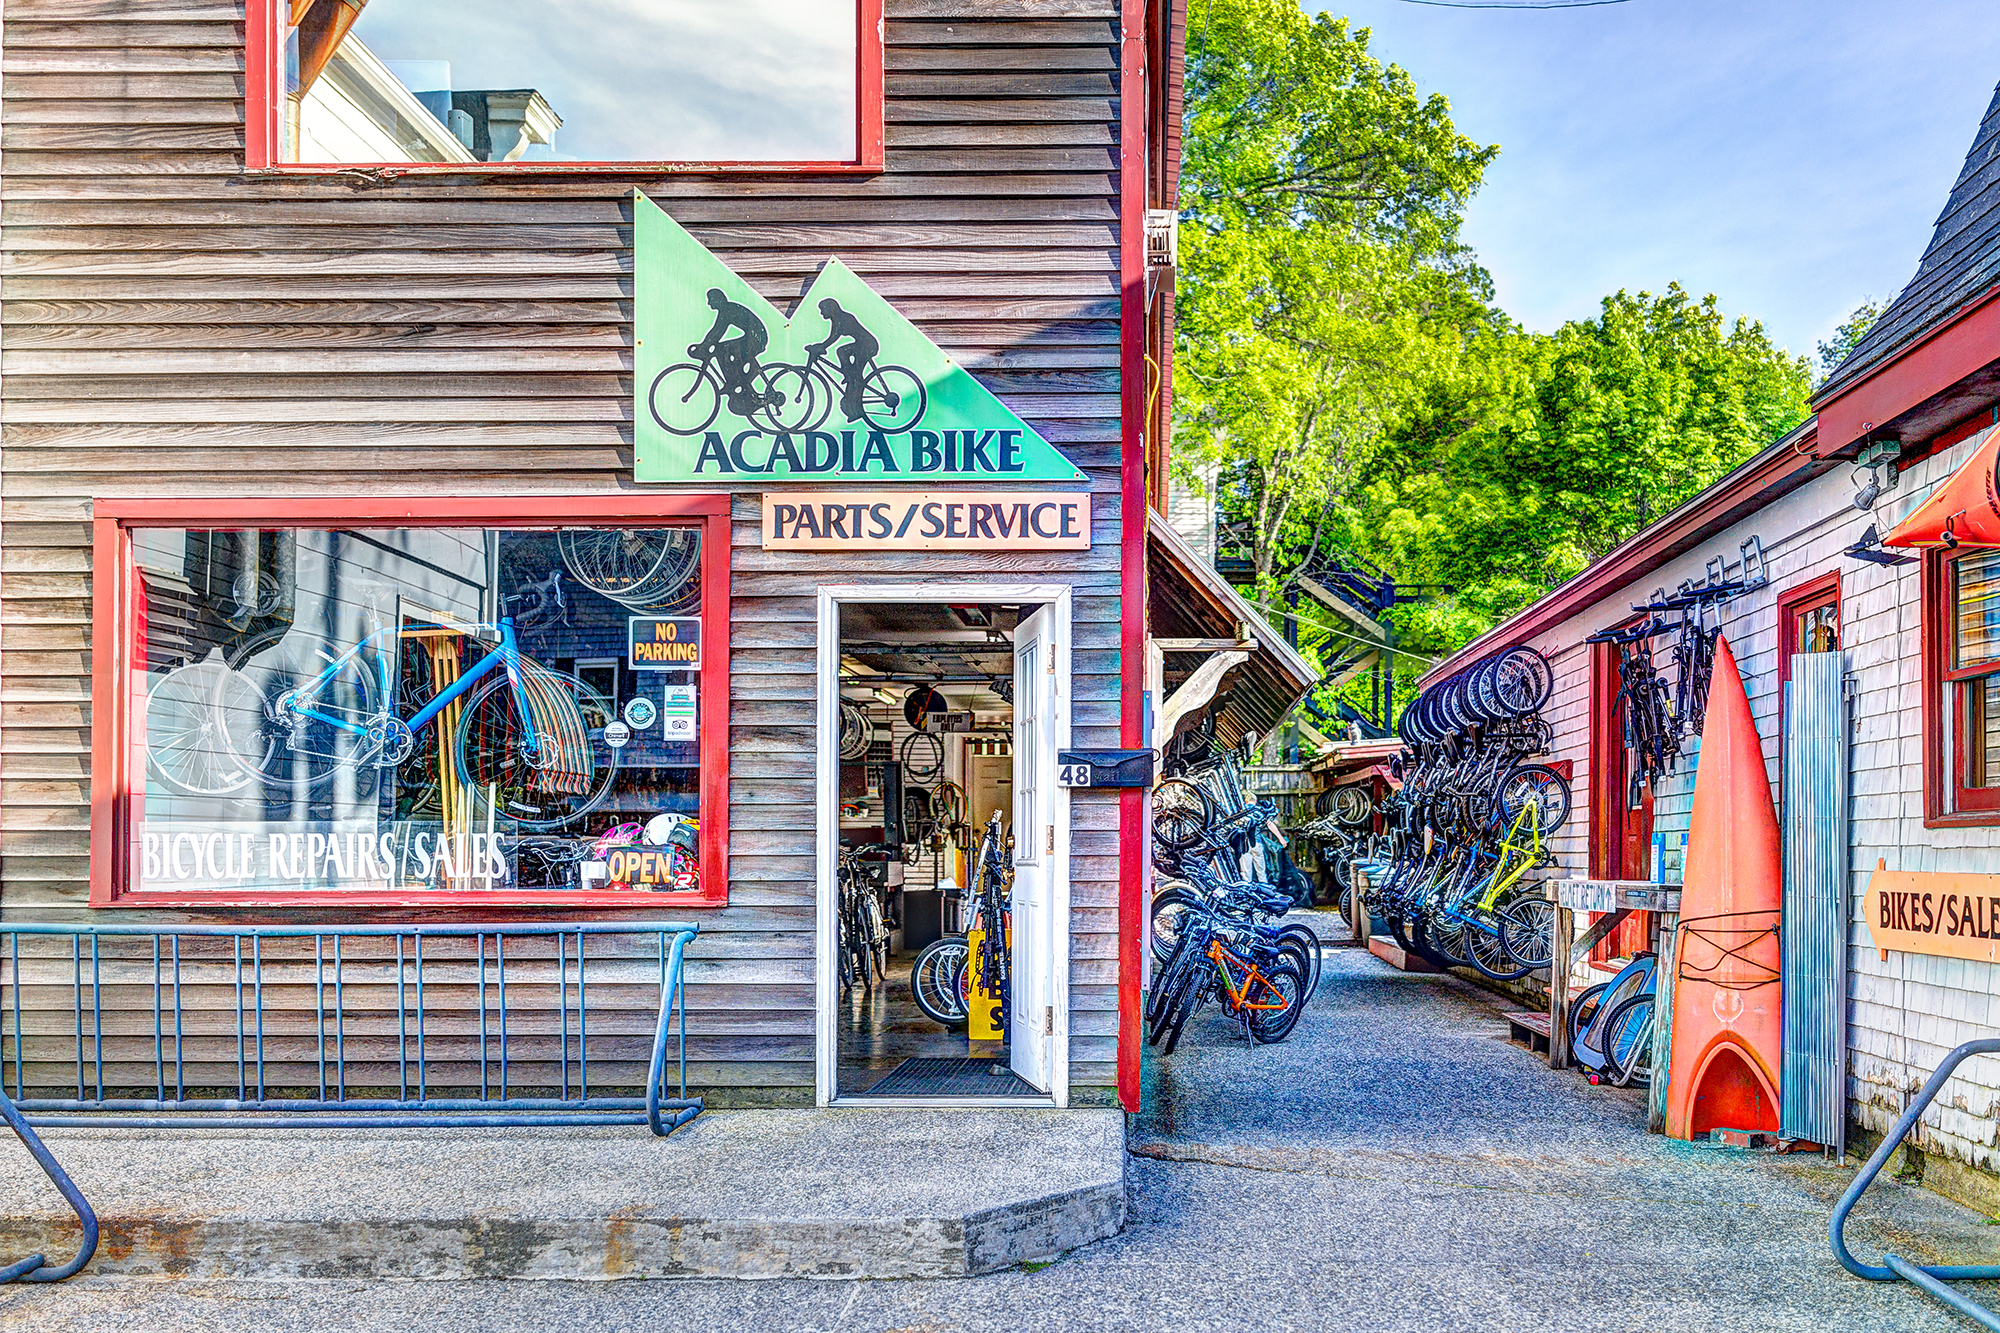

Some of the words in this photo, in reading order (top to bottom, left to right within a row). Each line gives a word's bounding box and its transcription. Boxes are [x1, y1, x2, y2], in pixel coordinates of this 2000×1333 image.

[693, 430, 896, 473] ACADIA
[909, 430, 1026, 472] BIKE
[772, 502, 1082, 540] PARTS/SERVICE
[655, 623, 677, 641] NO
[635, 642, 698, 661] PARKING
[1060, 766, 1089, 785] 48
[141, 832, 256, 880] BICYCLE
[609, 850, 672, 883] OPEN
